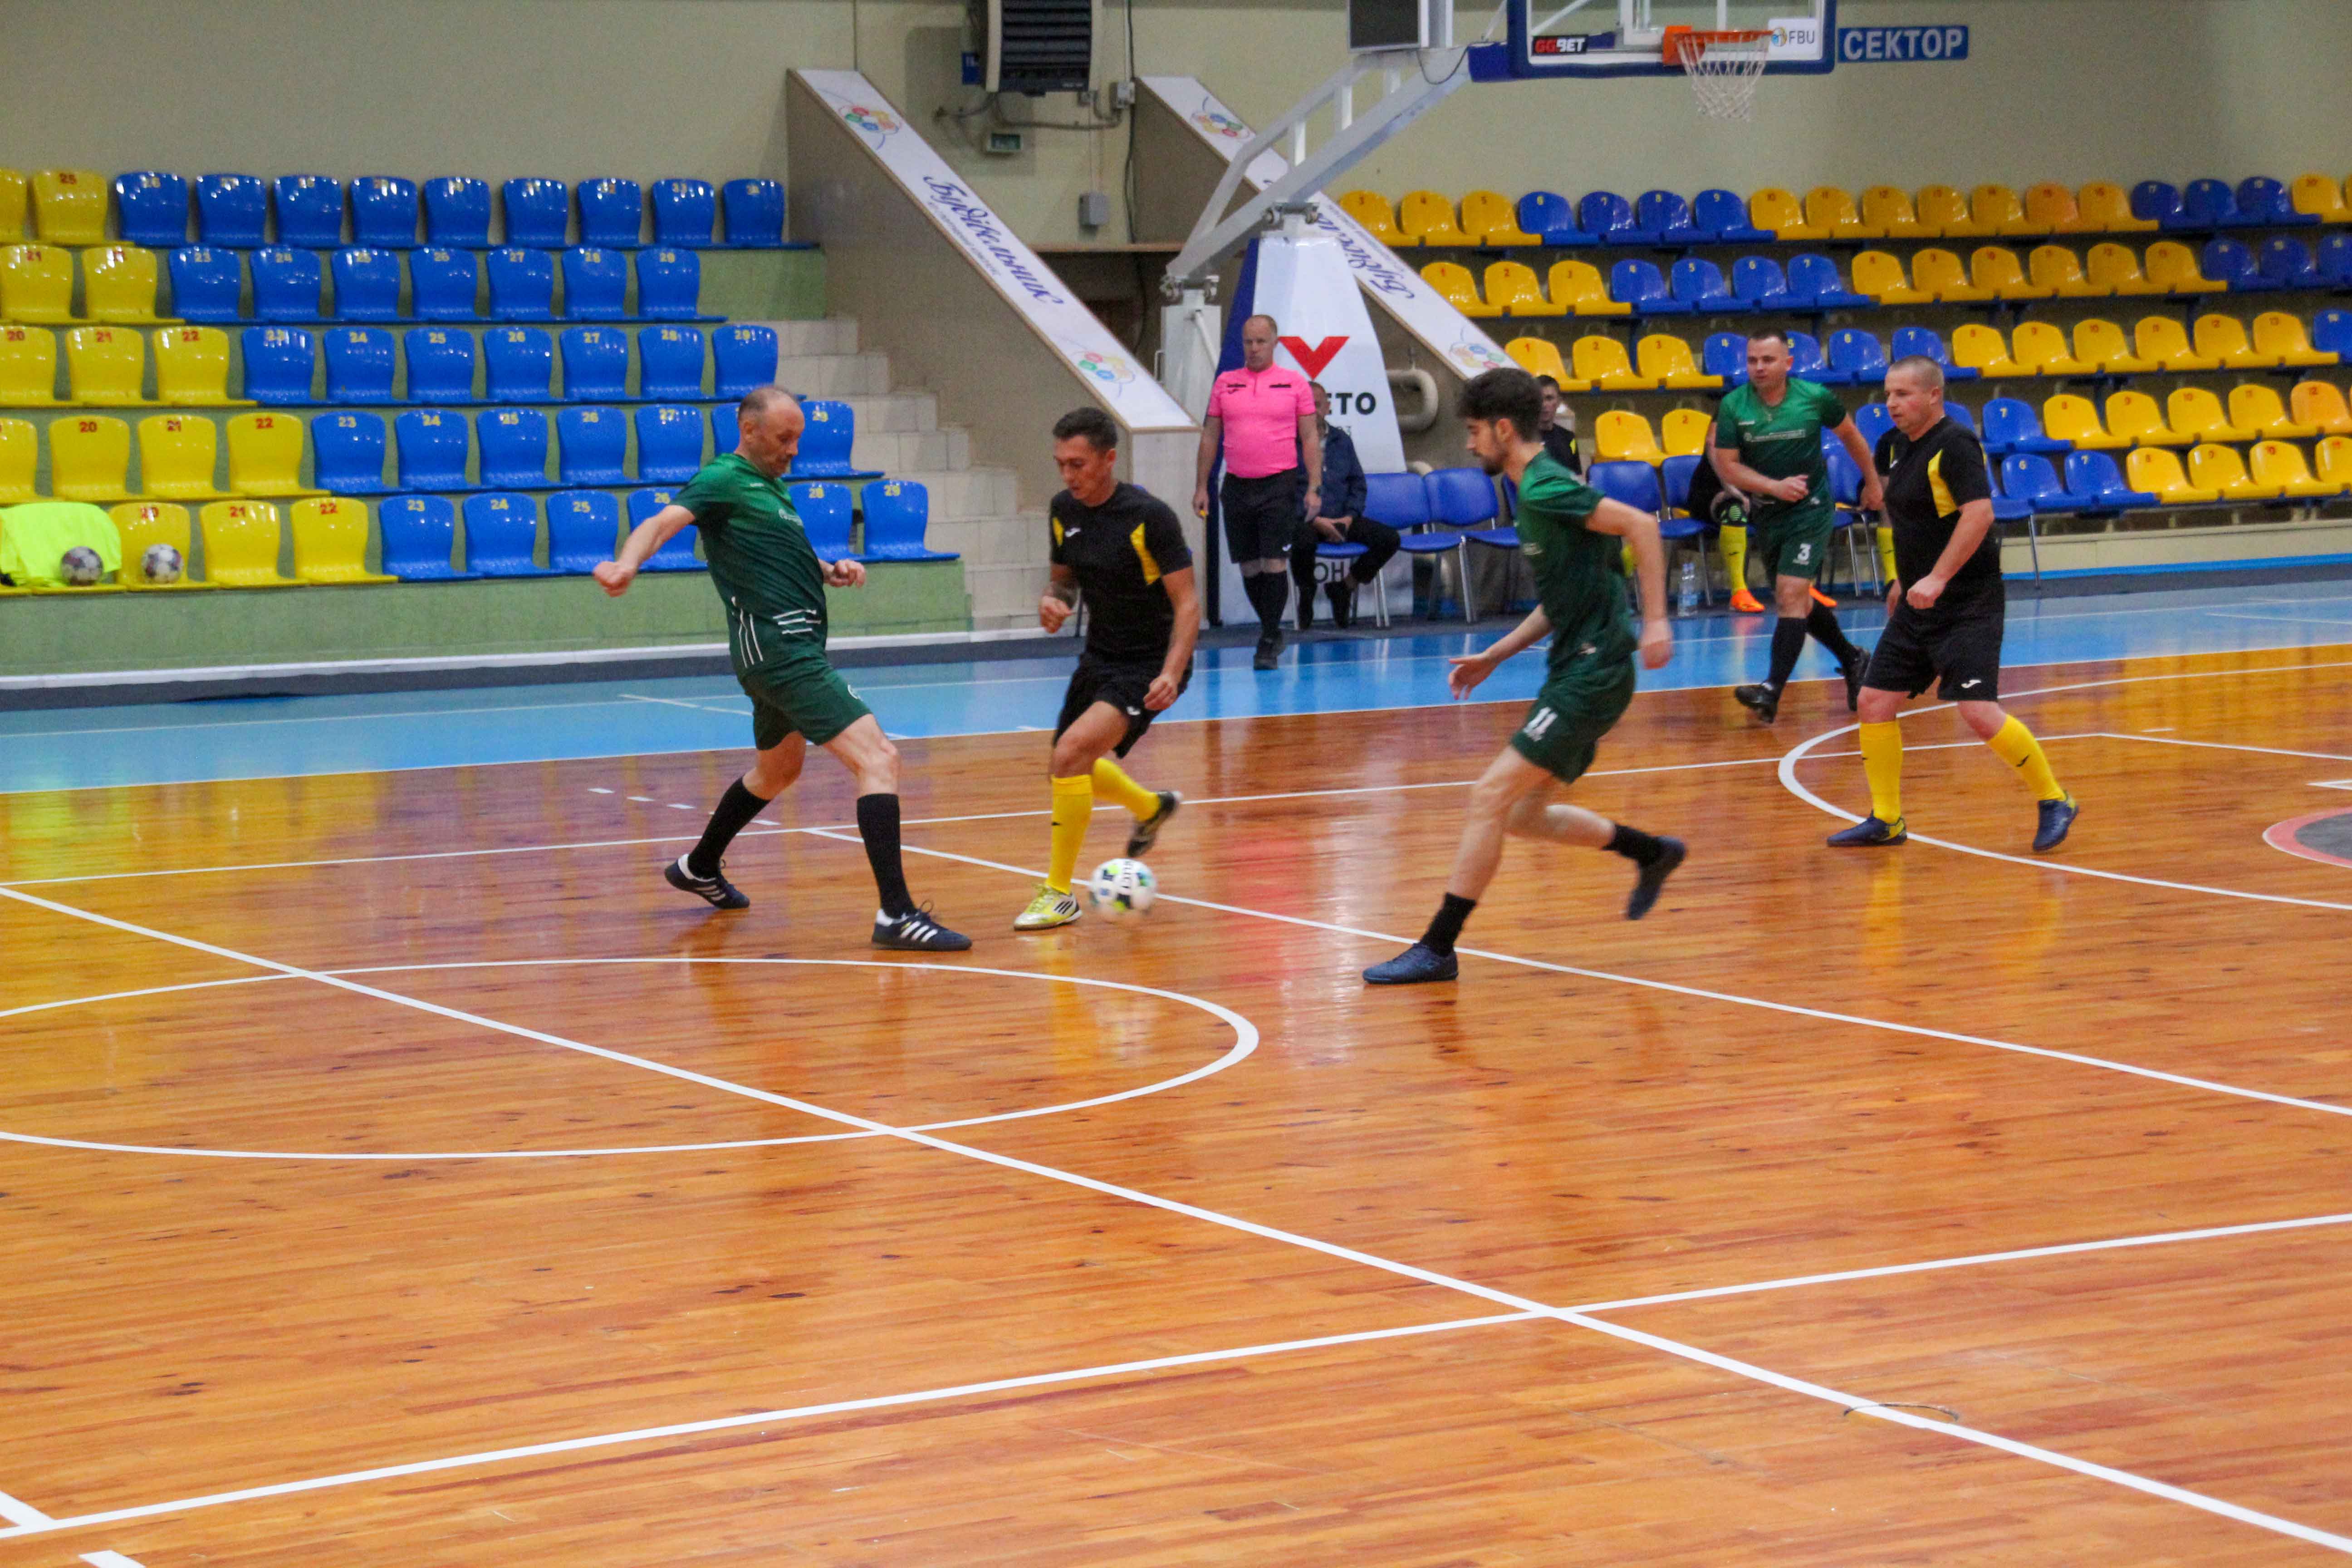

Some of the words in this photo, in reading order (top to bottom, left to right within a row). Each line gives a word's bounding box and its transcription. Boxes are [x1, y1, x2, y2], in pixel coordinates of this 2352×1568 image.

[1789, 31, 1815, 44] FBU
[1843, 29, 1963, 60] СЕКТОР
[1713, 193, 1720, 203] 9
[509, 251, 525, 262] 27
[1688, 262, 1695, 272] 5
[1749, 260, 1756, 270] 6
[1804, 259, 1811, 269] 7
[1440, 268, 1446, 276] 1
[1504, 268, 1510, 277] 2
[7, 331, 25, 341] 20
[96, 331, 113, 342] 21
[182, 331, 200, 342] 22
[349, 331, 368, 343] 24
[429, 332, 446, 343] 25
[508, 331, 525, 342] 26
[583, 332, 600, 343] 27
[661, 329, 678, 341] 28
[735, 329, 751, 340] 29
[1844, 333, 1852, 343] 6
[1908, 331, 1916, 341] 7
[1524, 343, 1530, 353] 1
[1593, 341, 1599, 351] 2
[1656, 340, 1662, 349] 3
[583, 412, 599, 423] 26
[659, 409, 676, 421] 27
[2000, 407, 2008, 418] 7
[255, 417, 274, 429] 22
[338, 416, 357, 428] 23
[422, 415, 441, 426] 24
[502, 413, 519, 425] 25
[1616, 416, 1622, 426] 1
[1682, 415, 1689, 425] 2
[78, 421, 98, 433] 20
[167, 420, 182, 432] 21
[2019, 461, 2027, 470] 6
[2081, 455, 2089, 465] 7
[884, 485, 901, 496] 29
[654, 492, 670, 504] 26
[320, 503, 338, 515] 22
[408, 500, 426, 512] 23
[490, 499, 509, 511] 24
[573, 500, 591, 513] 25
[229, 506, 246, 518] 21
[1799, 543, 1812, 561] 3
[1523, 707, 1558, 734] 11
